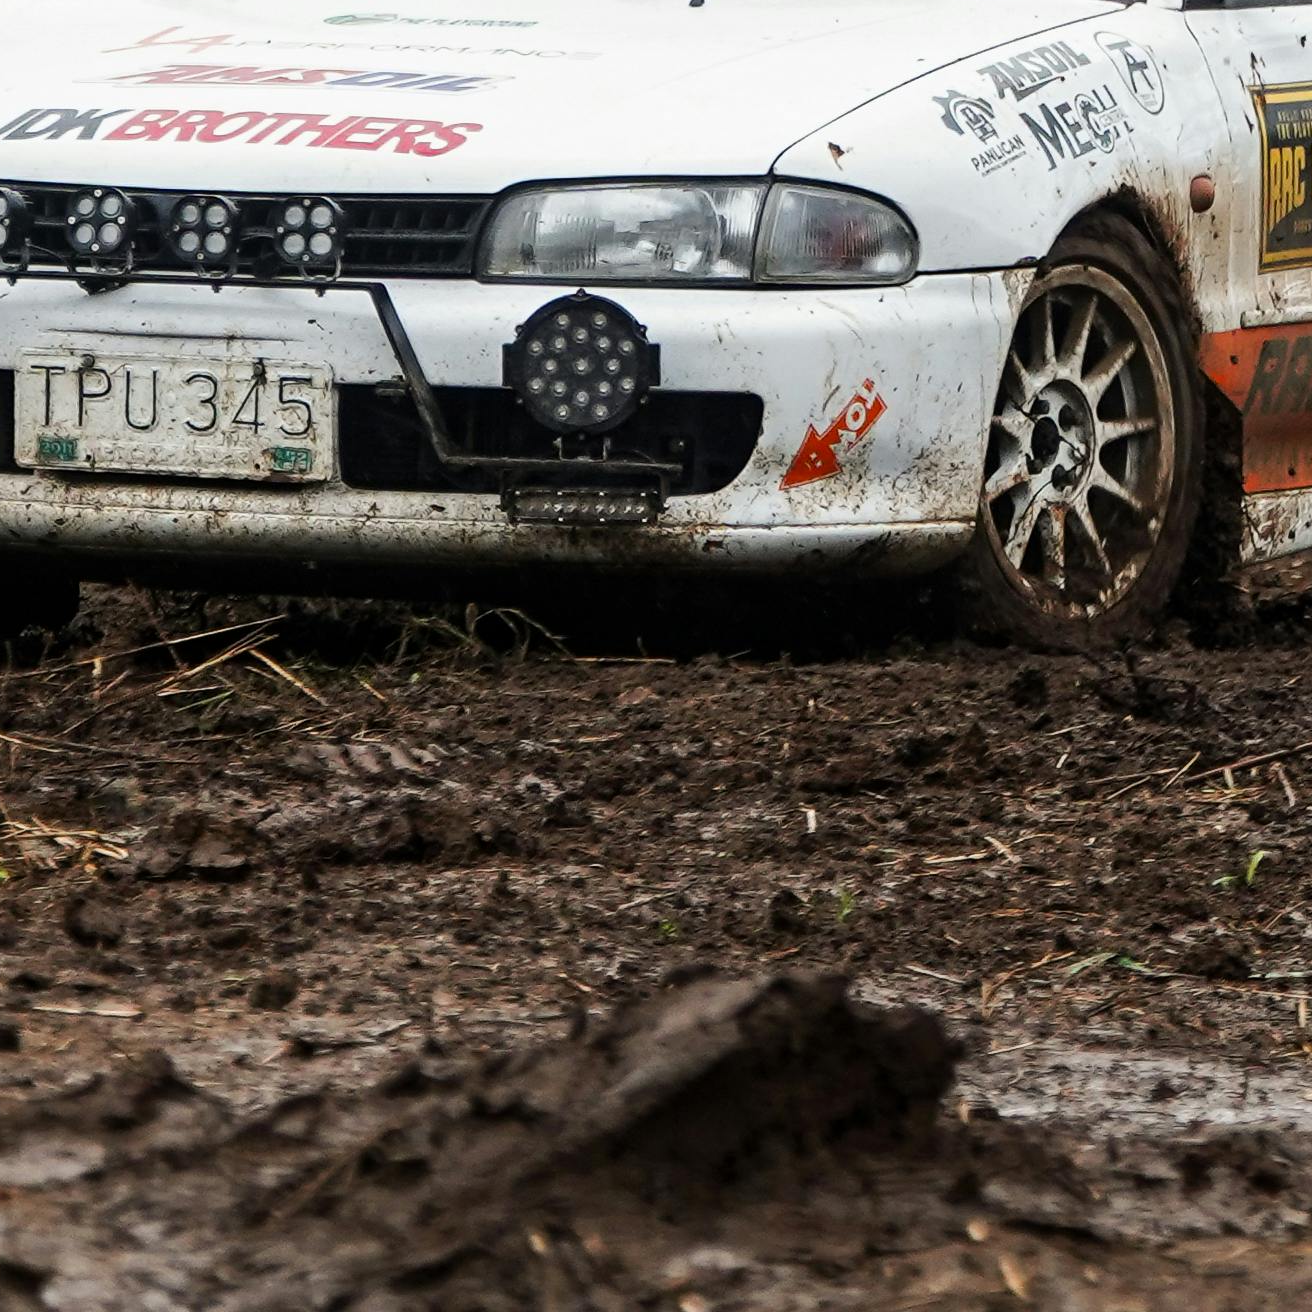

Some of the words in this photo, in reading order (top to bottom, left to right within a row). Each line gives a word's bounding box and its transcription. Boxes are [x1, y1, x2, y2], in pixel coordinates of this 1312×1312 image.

[97, 64, 490, 91] AMSOIL
[977, 40, 1091, 100] AMSOIL
[103, 109, 484, 157] BROTHERS
[970, 134, 1026, 172] PANLICAN
[31, 364, 158, 431] TPU
[184, 370, 313, 437] 345
